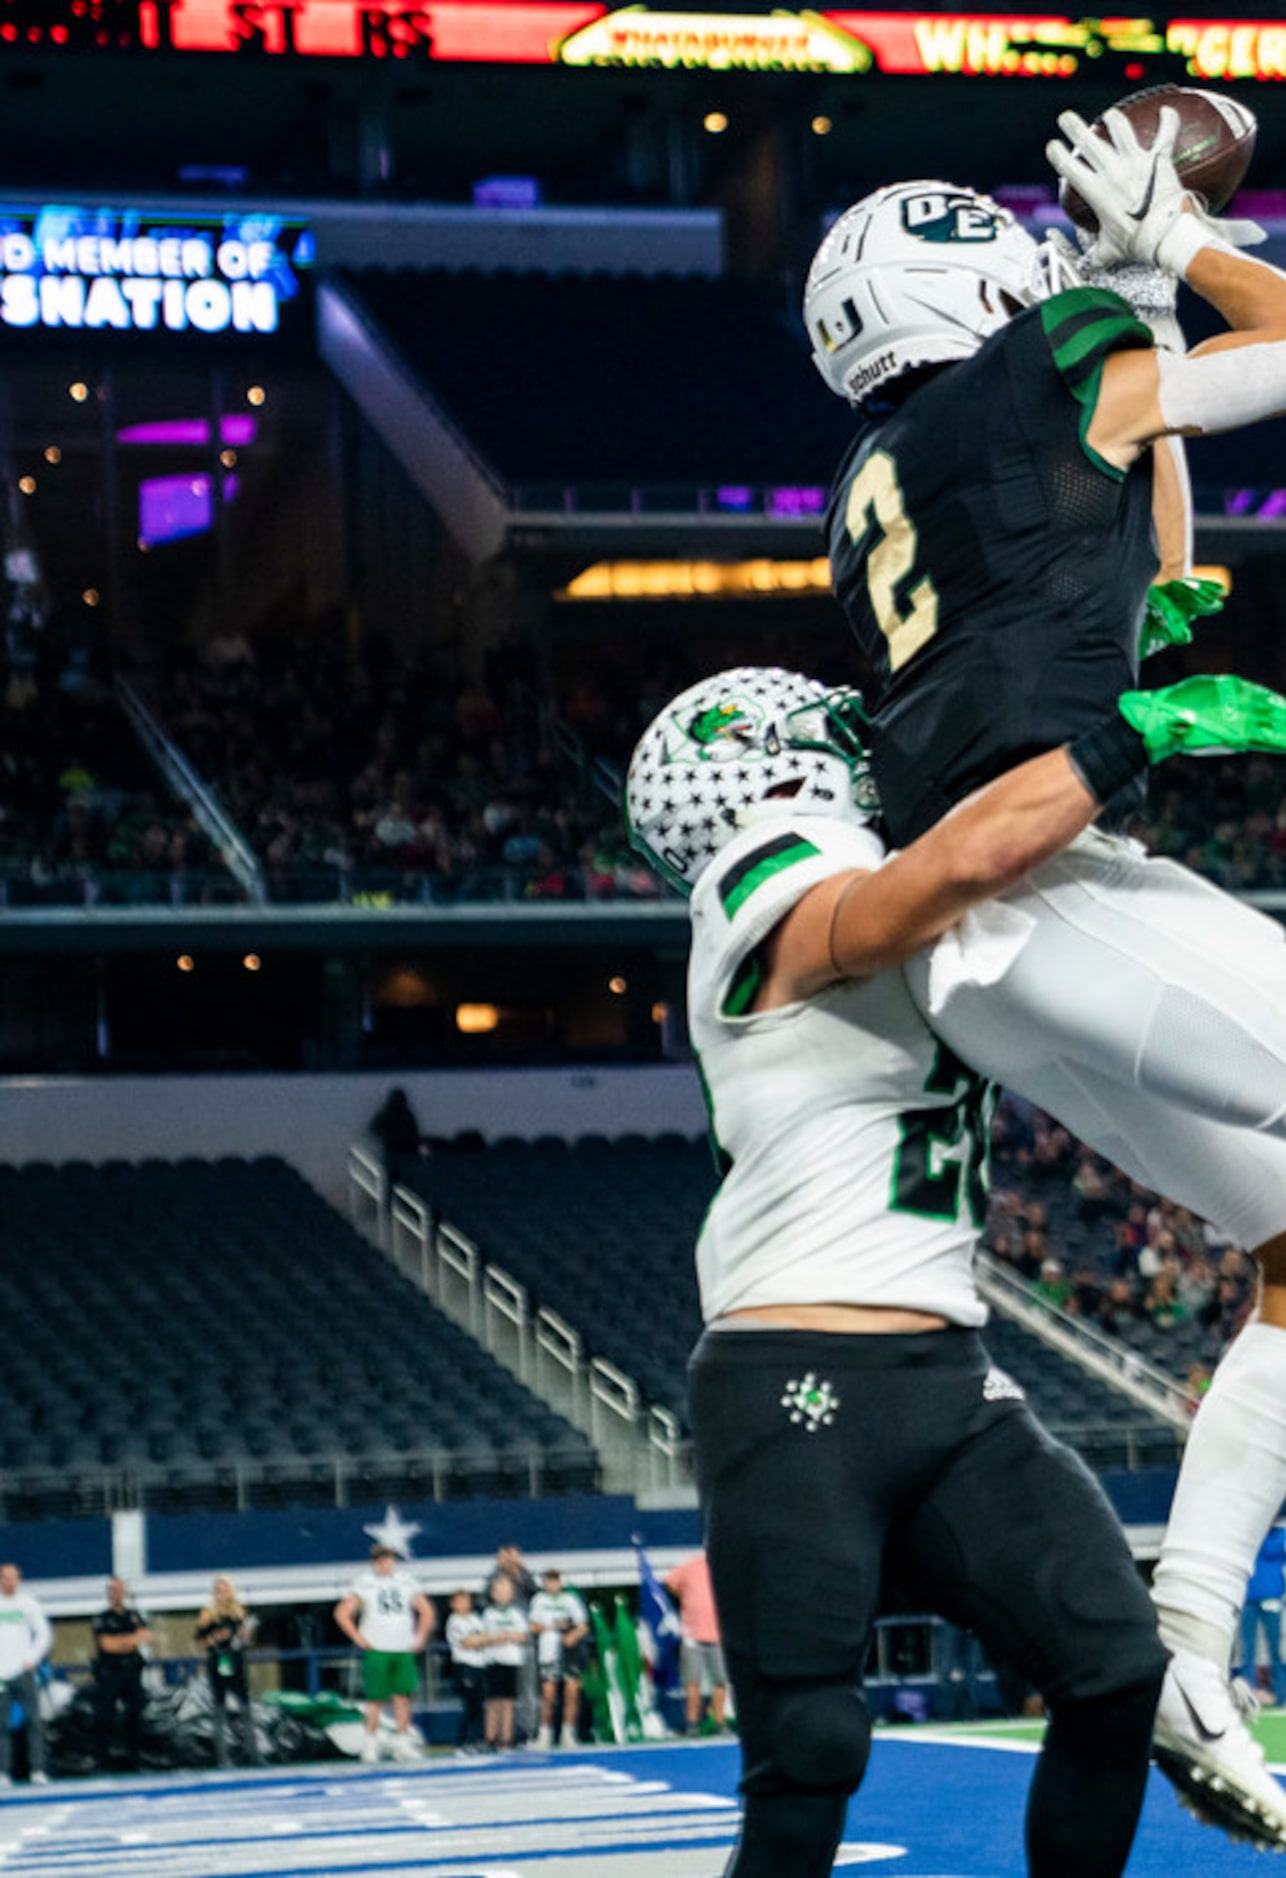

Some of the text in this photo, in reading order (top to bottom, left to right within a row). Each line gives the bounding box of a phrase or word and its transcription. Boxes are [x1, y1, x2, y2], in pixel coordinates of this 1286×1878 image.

[44, 236, 214, 278] MEMBER
[216, 240, 275, 279] OF
[848, 350, 898, 396] schutt
[845, 449, 939, 672] 2
